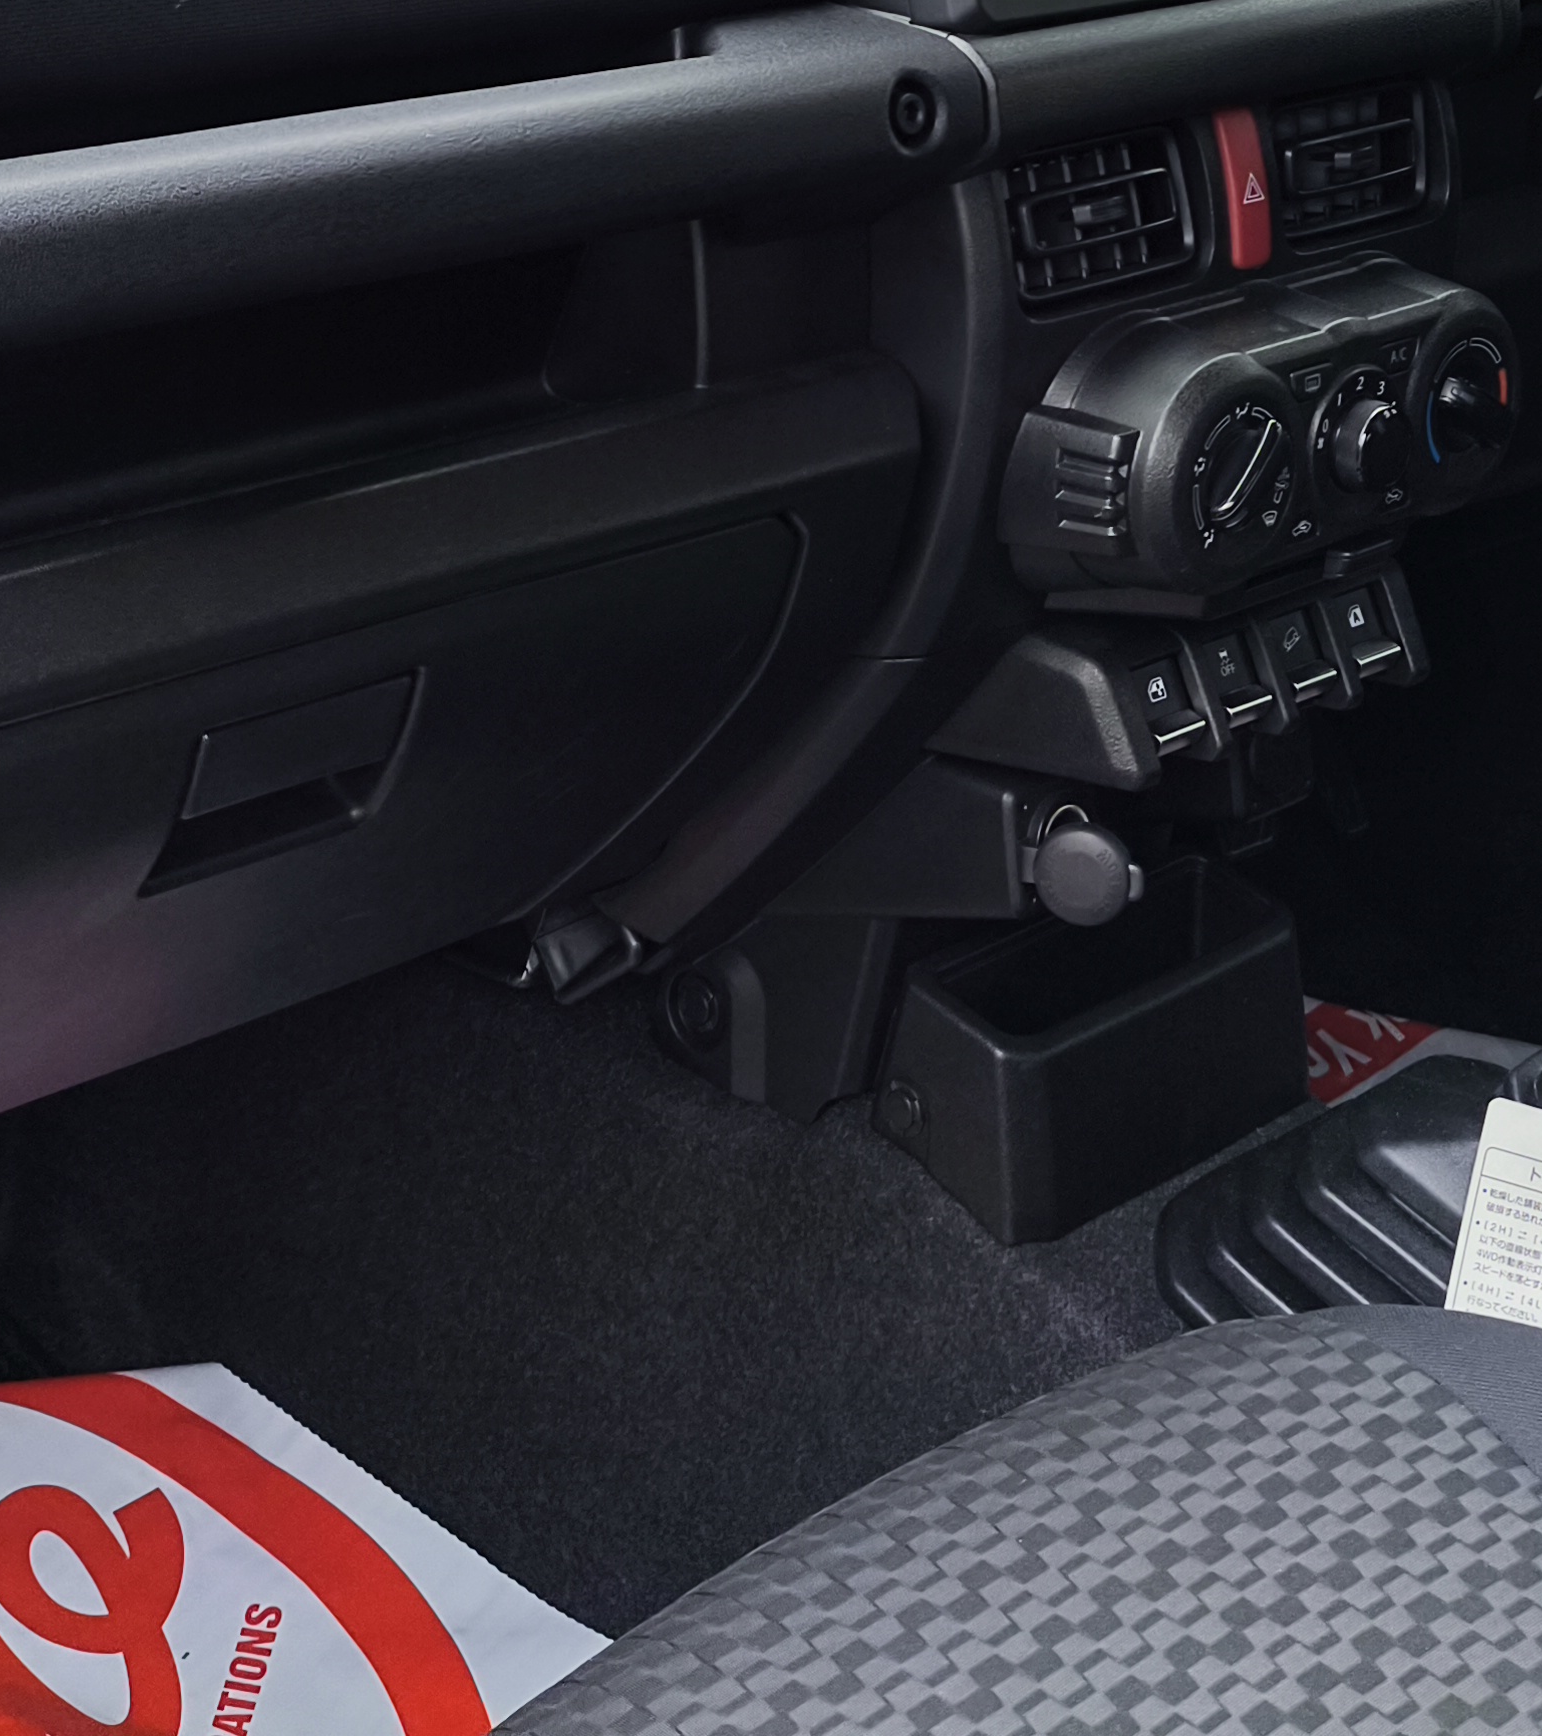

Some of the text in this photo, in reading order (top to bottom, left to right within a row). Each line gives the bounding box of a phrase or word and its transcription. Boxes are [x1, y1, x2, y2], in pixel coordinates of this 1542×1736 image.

[1355, 375, 1365, 391] 2
[1376, 380, 1386, 396] 3
[1466, 1295, 1538, 1323] 行なってください。
[212, 1603, 283, 1736] ATIONS
